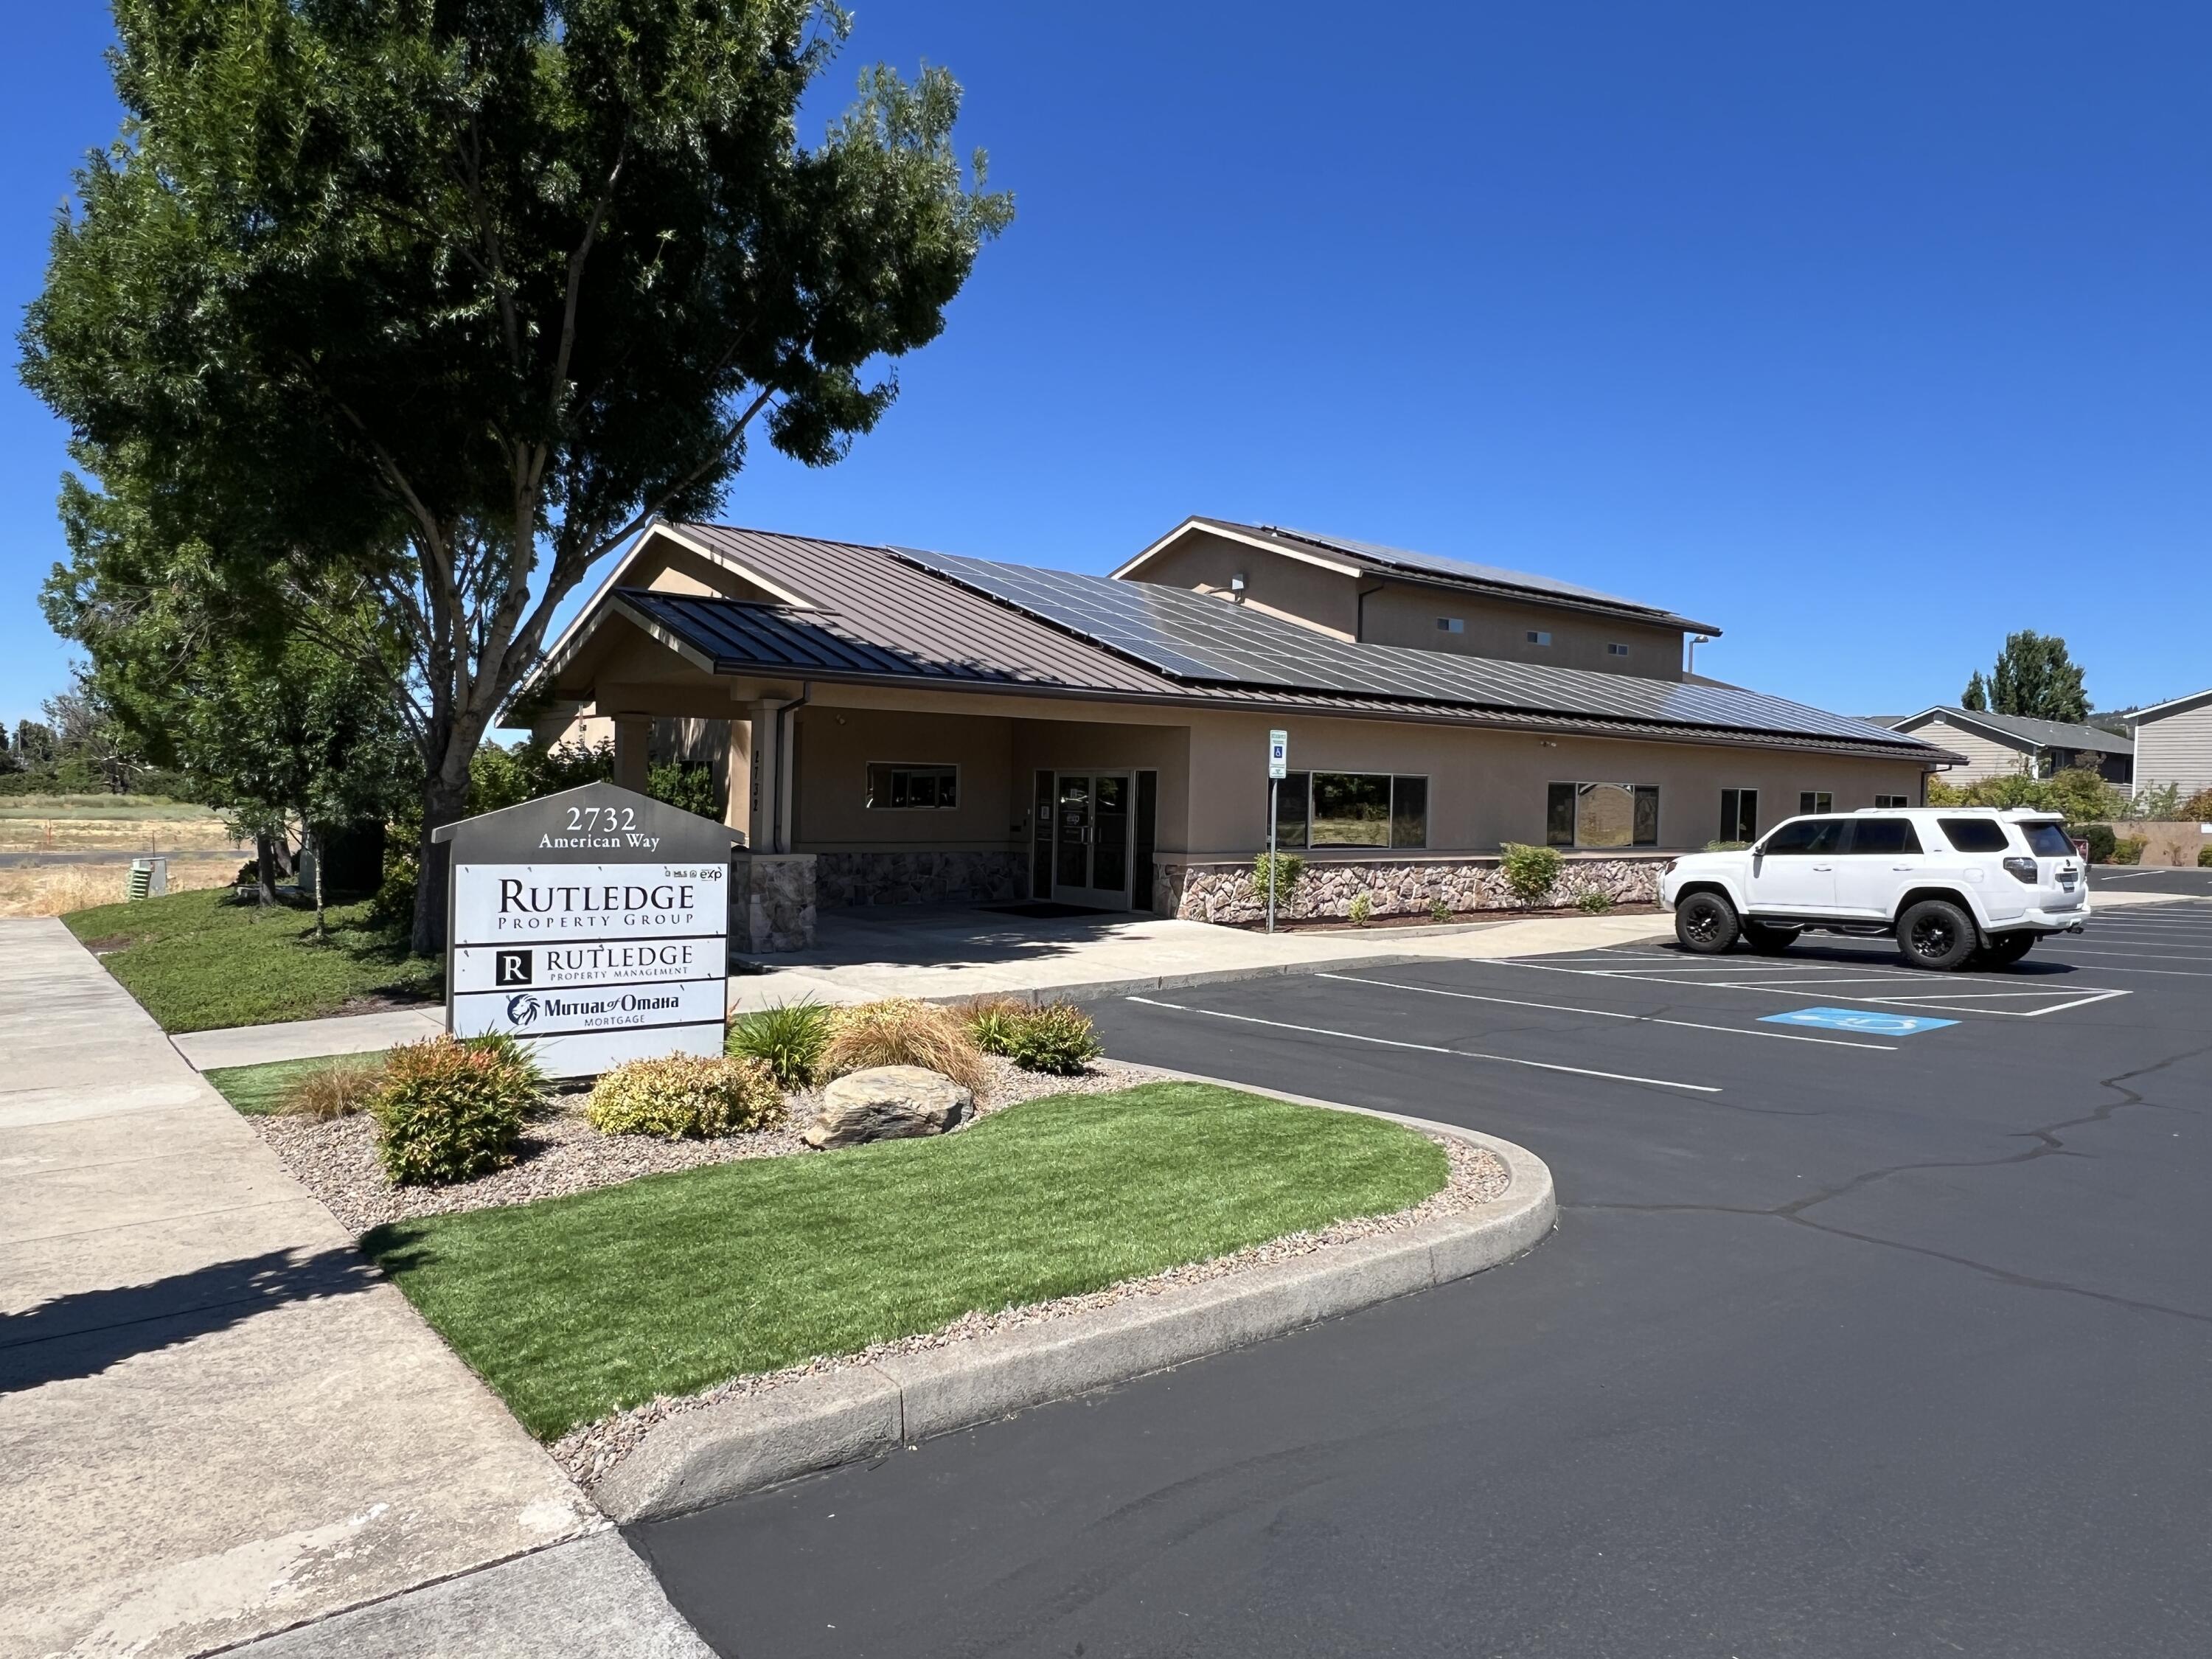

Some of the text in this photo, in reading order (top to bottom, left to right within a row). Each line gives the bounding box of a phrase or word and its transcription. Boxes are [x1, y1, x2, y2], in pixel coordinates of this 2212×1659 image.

[566, 807, 636, 832] 2732
[539, 833, 660, 852] American Way
[498, 879, 694, 914] RUTLEDGE
[498, 914, 693, 929] PROPERTY GROUP
[503, 956, 529, 980] R
[547, 945, 692, 971] RUTLEDGE
[551, 967, 688, 981] PROPERTY MANAGEMENT
[584, 1015, 645, 1027] MORTGAGE
